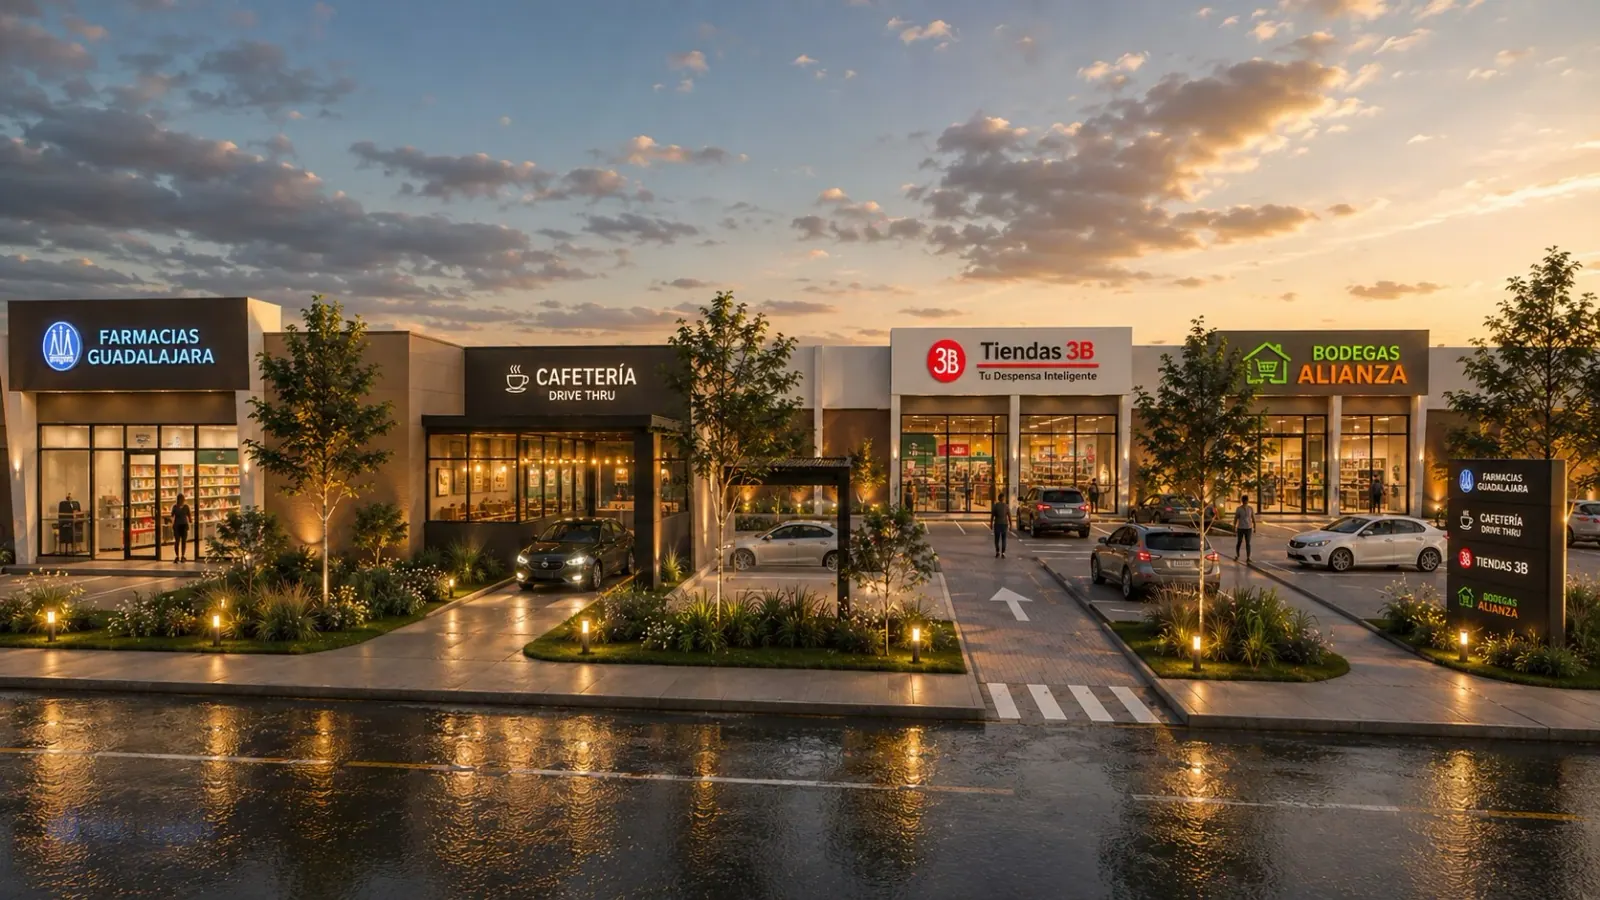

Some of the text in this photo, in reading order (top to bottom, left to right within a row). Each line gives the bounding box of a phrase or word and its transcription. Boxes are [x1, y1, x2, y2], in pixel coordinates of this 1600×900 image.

[100, 328, 199, 345] FARMACIAS
[88, 348, 215, 365] GUADALAJARA
[980, 341, 1094, 360] Tiendas 3B
[1313, 345, 1400, 361] BODEGAS
[933, 347, 960, 374] 3B
[536, 363, 637, 386] CAFETERÍA
[979, 371, 1097, 383] Tu Despensa Inteligente
[1297, 364, 1408, 384] ALIANZA
[549, 390, 616, 401] DRIVE THRU
[1482, 472, 1523, 483] FARMACIAS
[1477, 482, 1529, 493] GUADALAJARA
[1480, 513, 1524, 527] CAFETERÍA
[1481, 525, 1522, 538] DRIVE THRU
[1475, 556, 1529, 575] TIENDAS 3B
[1483, 592, 1518, 607] BODEGAS
[1477, 600, 1519, 619] ALIANZA
